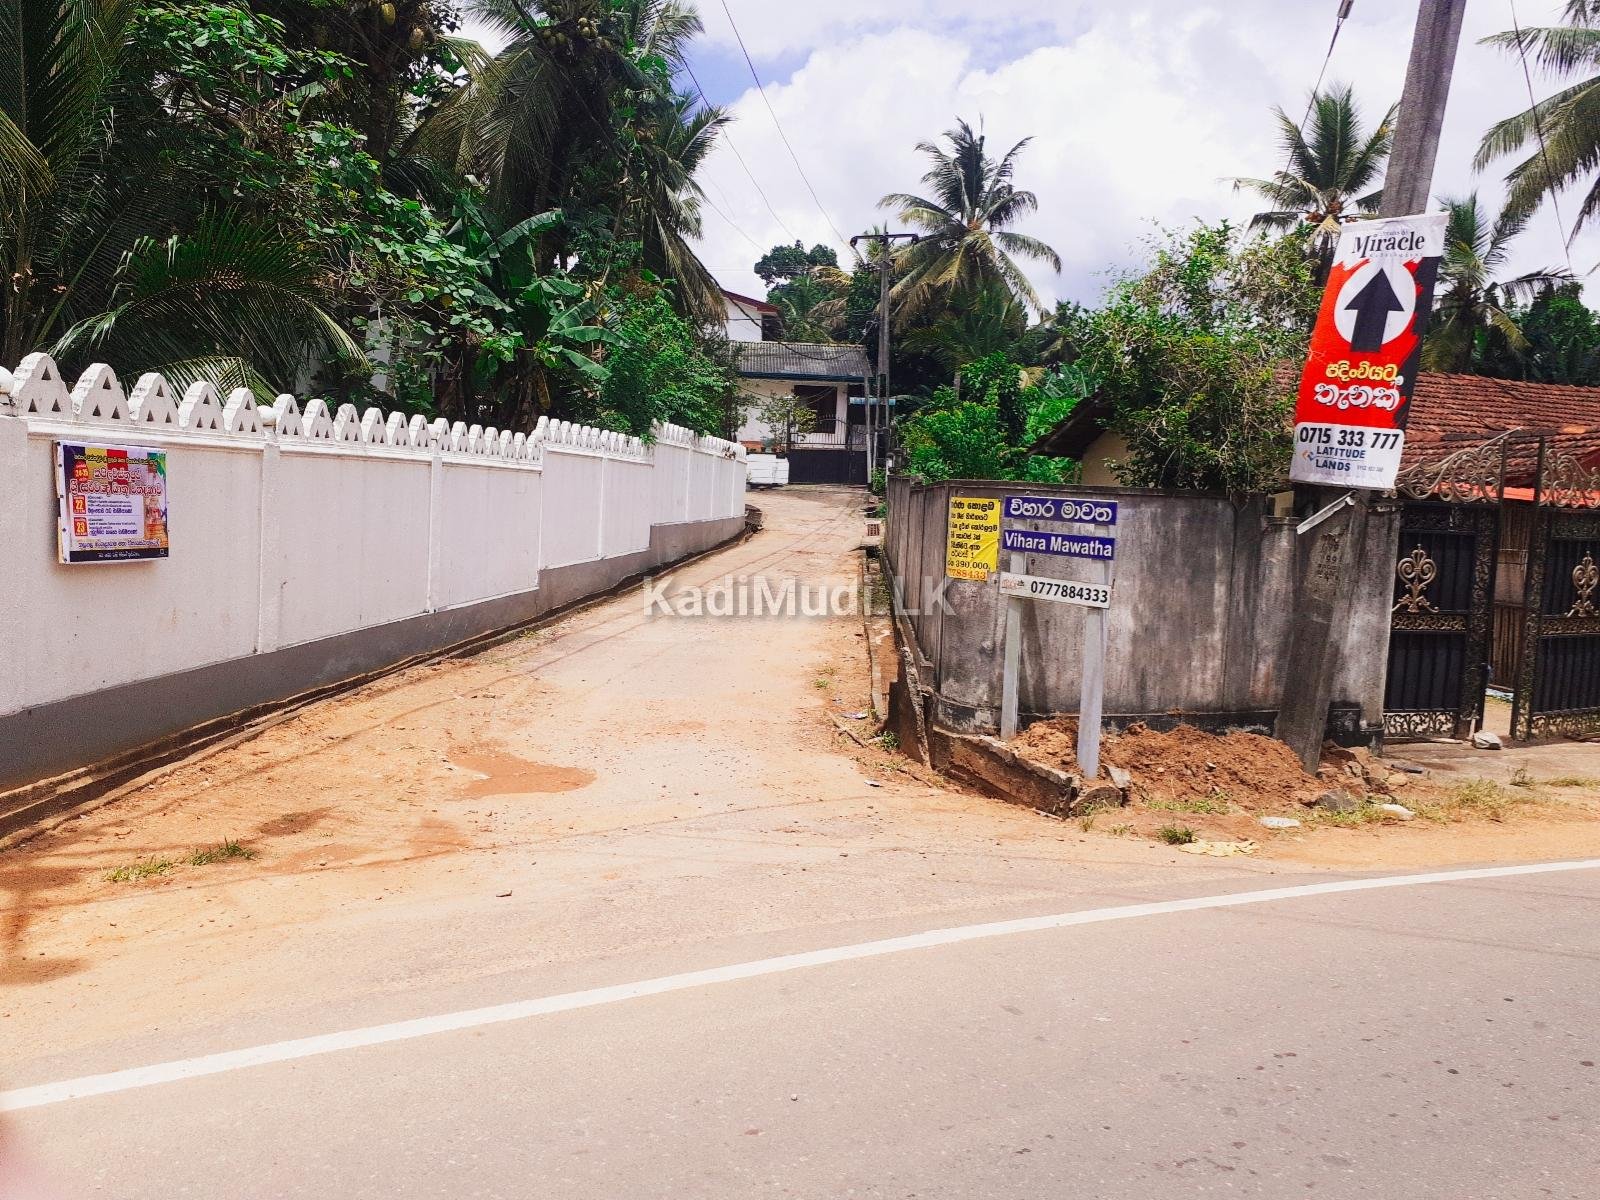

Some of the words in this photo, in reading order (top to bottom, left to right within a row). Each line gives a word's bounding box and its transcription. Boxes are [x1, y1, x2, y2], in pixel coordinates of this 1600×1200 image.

[1352, 231, 1425, 258] Miracle
[1326, 360, 1398, 381] පදිංචියට
[1299, 427, 1332, 444] 0715
[1337, 429, 1365, 447] 333
[1370, 432, 1400, 450] 777
[1316, 445, 1366, 459] LATITUDE
[1315, 459, 1351, 471] LANDS
[1010, 498, 1055, 517] විහාර
[1061, 501, 1112, 521] මාවත
[1004, 532, 1046, 551] Vihara
[1050, 536, 1112, 557] Mawatha
[1030, 580, 1108, 603] 0777884333
